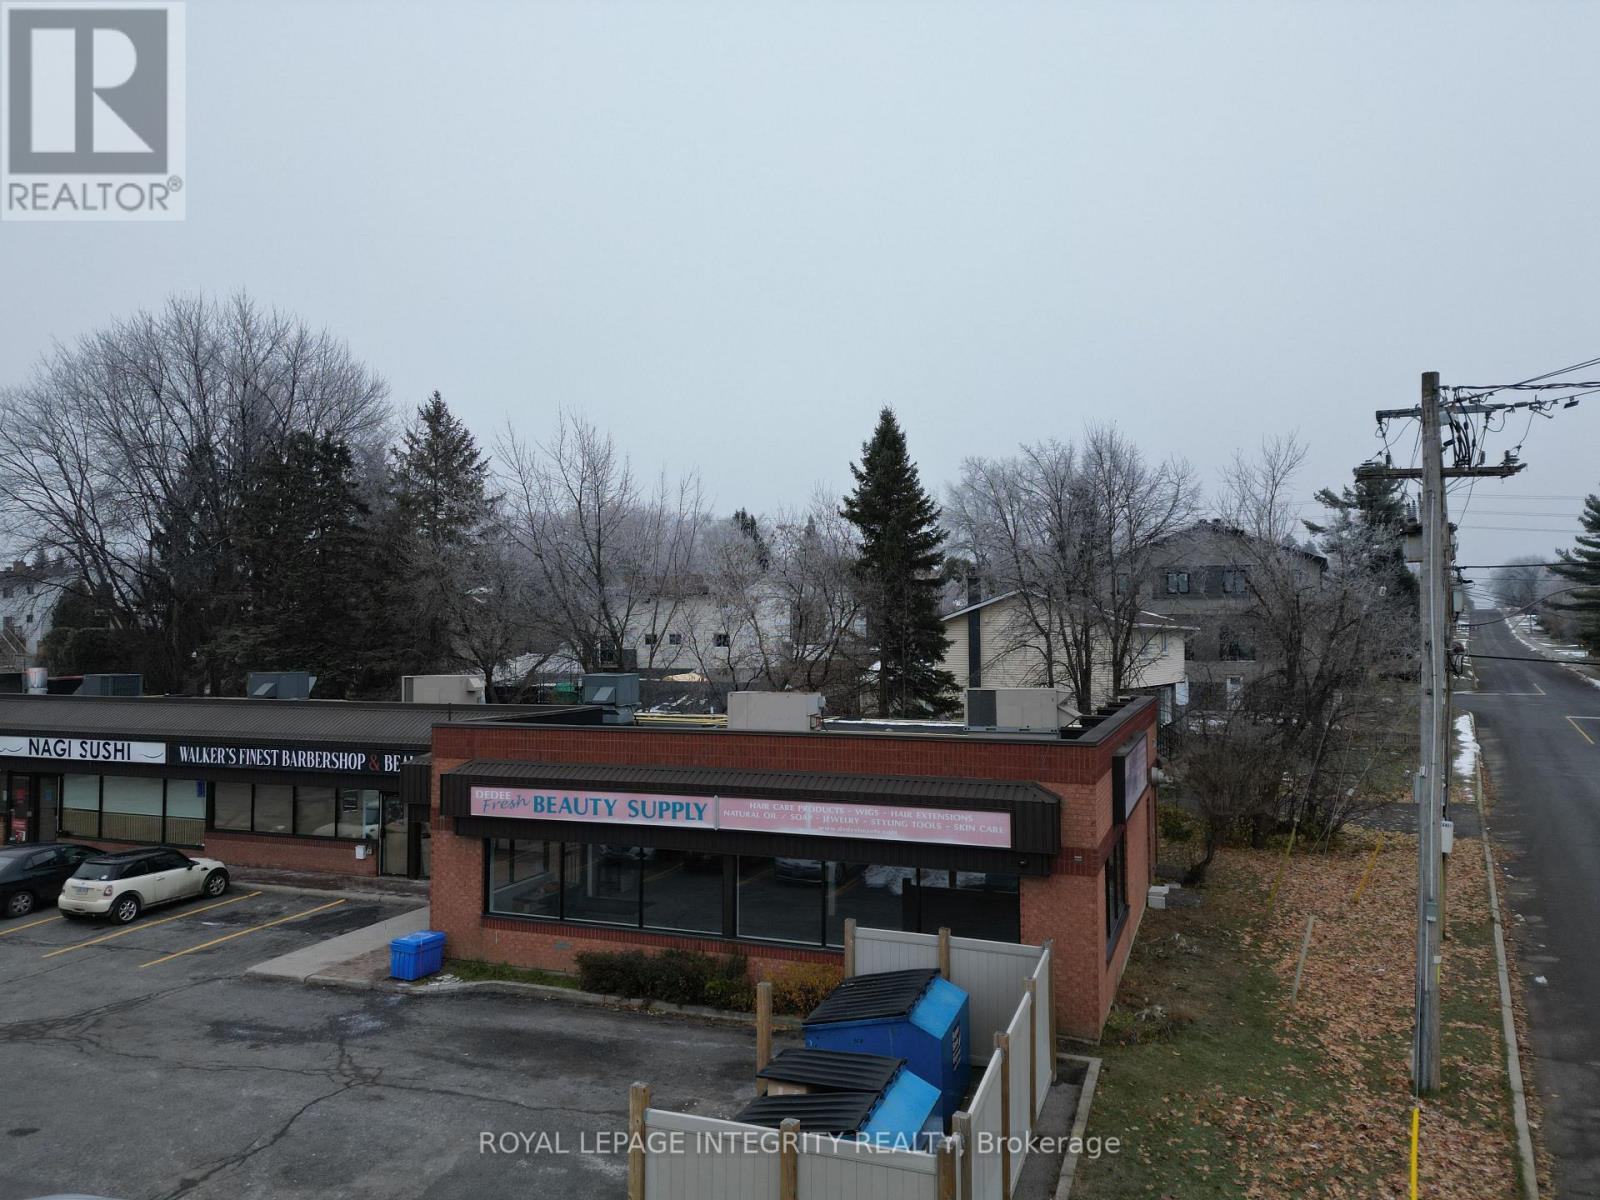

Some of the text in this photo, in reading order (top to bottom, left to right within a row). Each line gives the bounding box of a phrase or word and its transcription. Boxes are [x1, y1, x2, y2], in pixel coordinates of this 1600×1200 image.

[28, 738, 131, 761] NAGI SUSHI
[179, 745, 237, 764] WALKER'S
[239, 748, 279, 766] FINEST
[282, 749, 366, 771] BARBERSHOP
[368, 753, 380, 772] &
[475, 789, 512, 800] DEDEE
[481, 794, 529, 814] Fresh
[533, 795, 708, 821] BEAUTY SUPPLY
[749, 802, 974, 822] HAIR CARE PRODUCTS WIGS HAIR EXTENSIONS
[723, 809, 760, 818] NATURAL
[763, 812, 776, 820] OIL
[823, 815, 859, 825] JEWELRY
[871, 818, 908, 828] STYLING
[912, 821, 943, 831] TOOLS
[953, 823, 976, 832] SKIN
[979, 825, 1005, 834] CARE
